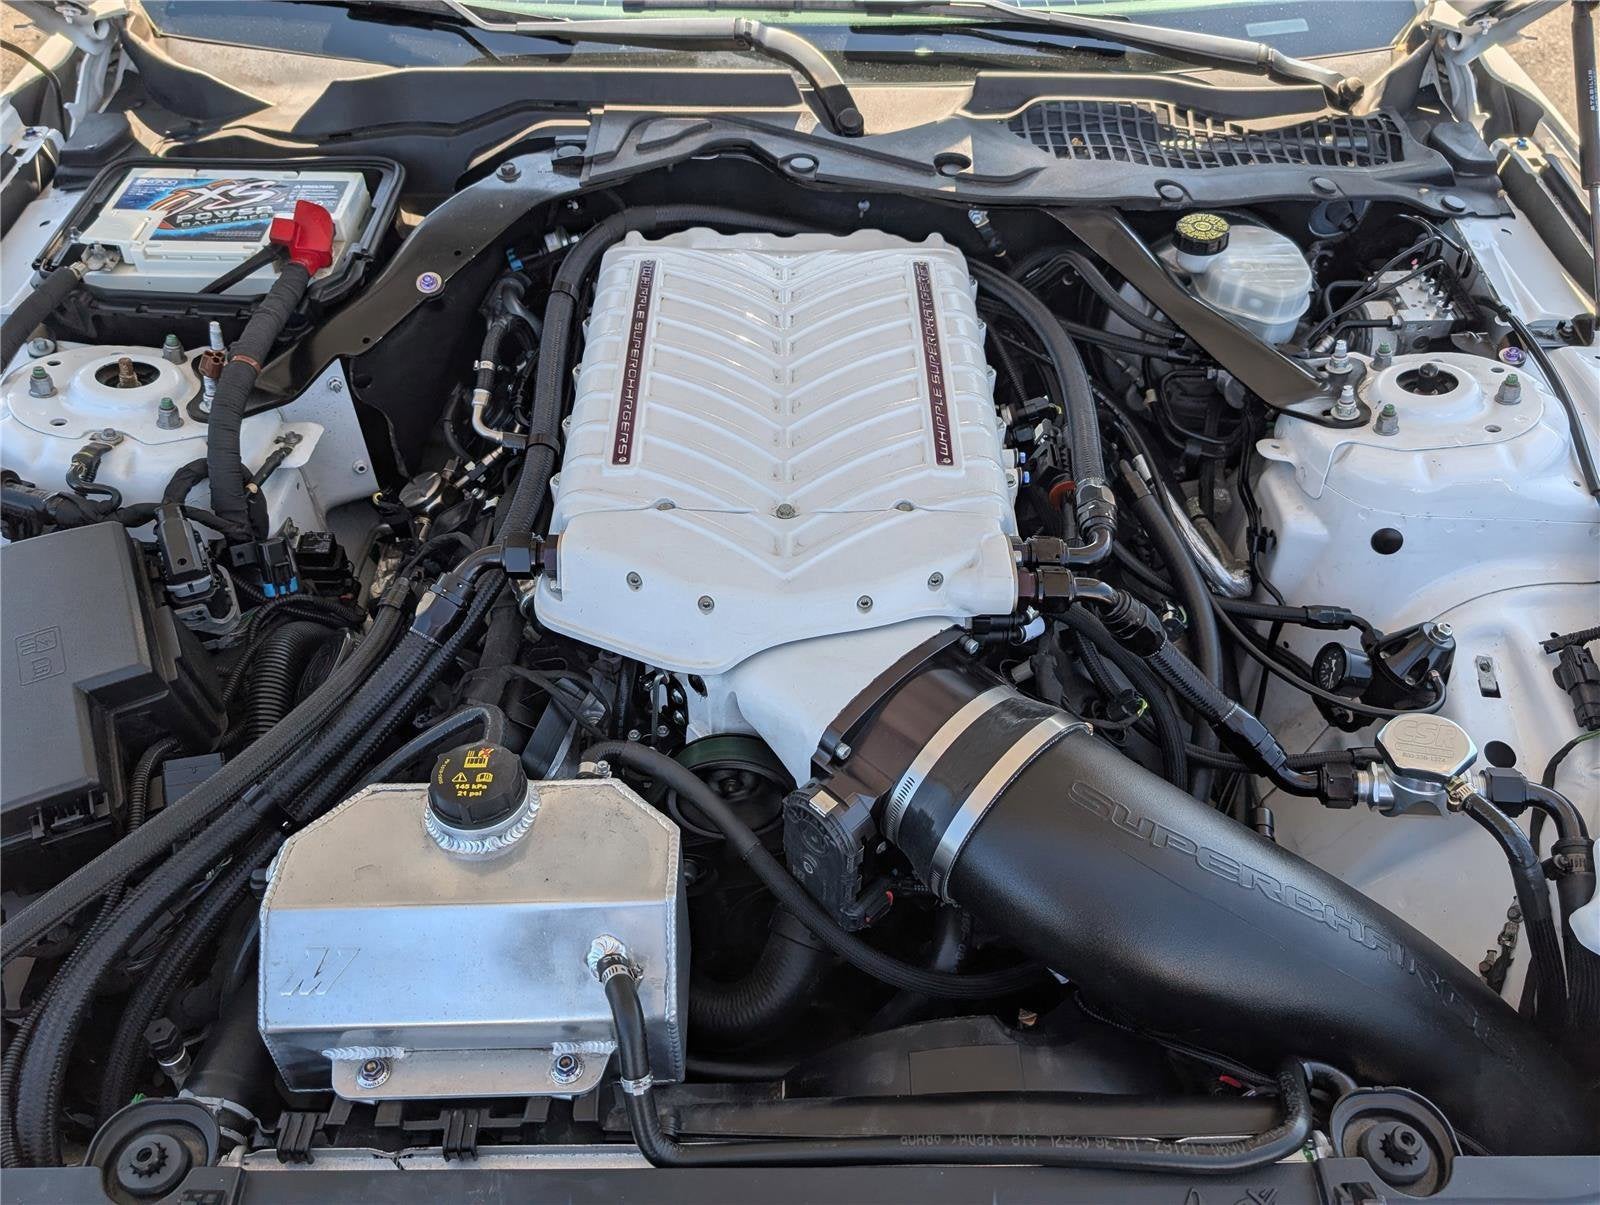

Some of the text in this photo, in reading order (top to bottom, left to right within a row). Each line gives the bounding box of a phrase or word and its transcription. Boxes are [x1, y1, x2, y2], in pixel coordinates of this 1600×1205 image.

[166, 180, 277, 217] XS
[176, 205, 274, 224] POWER
[617, 322, 643, 455] SUPERCHARGERS
[932, 387, 949, 456] WHIPPLE
